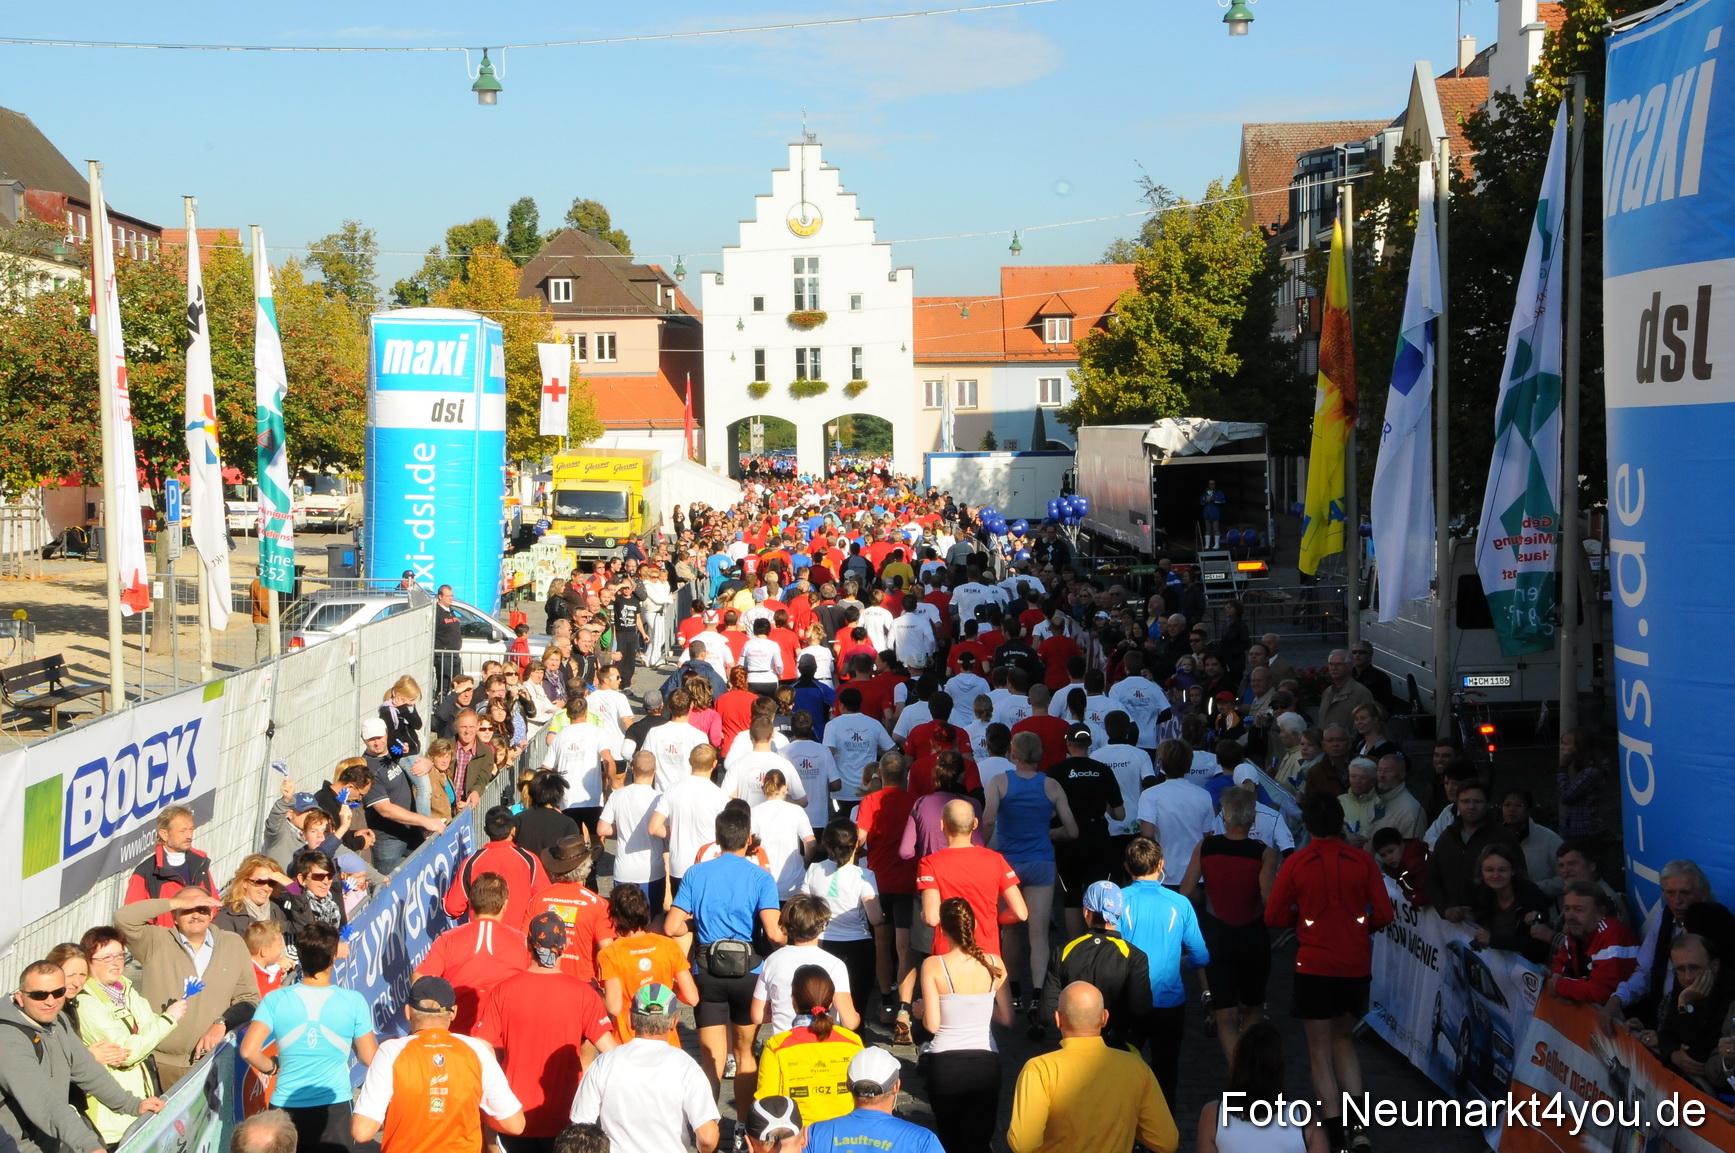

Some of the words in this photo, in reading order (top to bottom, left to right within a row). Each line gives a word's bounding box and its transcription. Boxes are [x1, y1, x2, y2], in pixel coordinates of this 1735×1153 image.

[1603, 26, 1722, 218] maxi
[382, 333, 469, 376] maxi
[1636, 284, 1713, 384] dsl
[431, 398, 465, 424] dsl
[404, 442, 436, 592] axi-dsl.de
[64, 718, 202, 860] BOCK
[1531, 1040, 1570, 1084] Selber
[833, 1134, 893, 1151] Lauftreff
